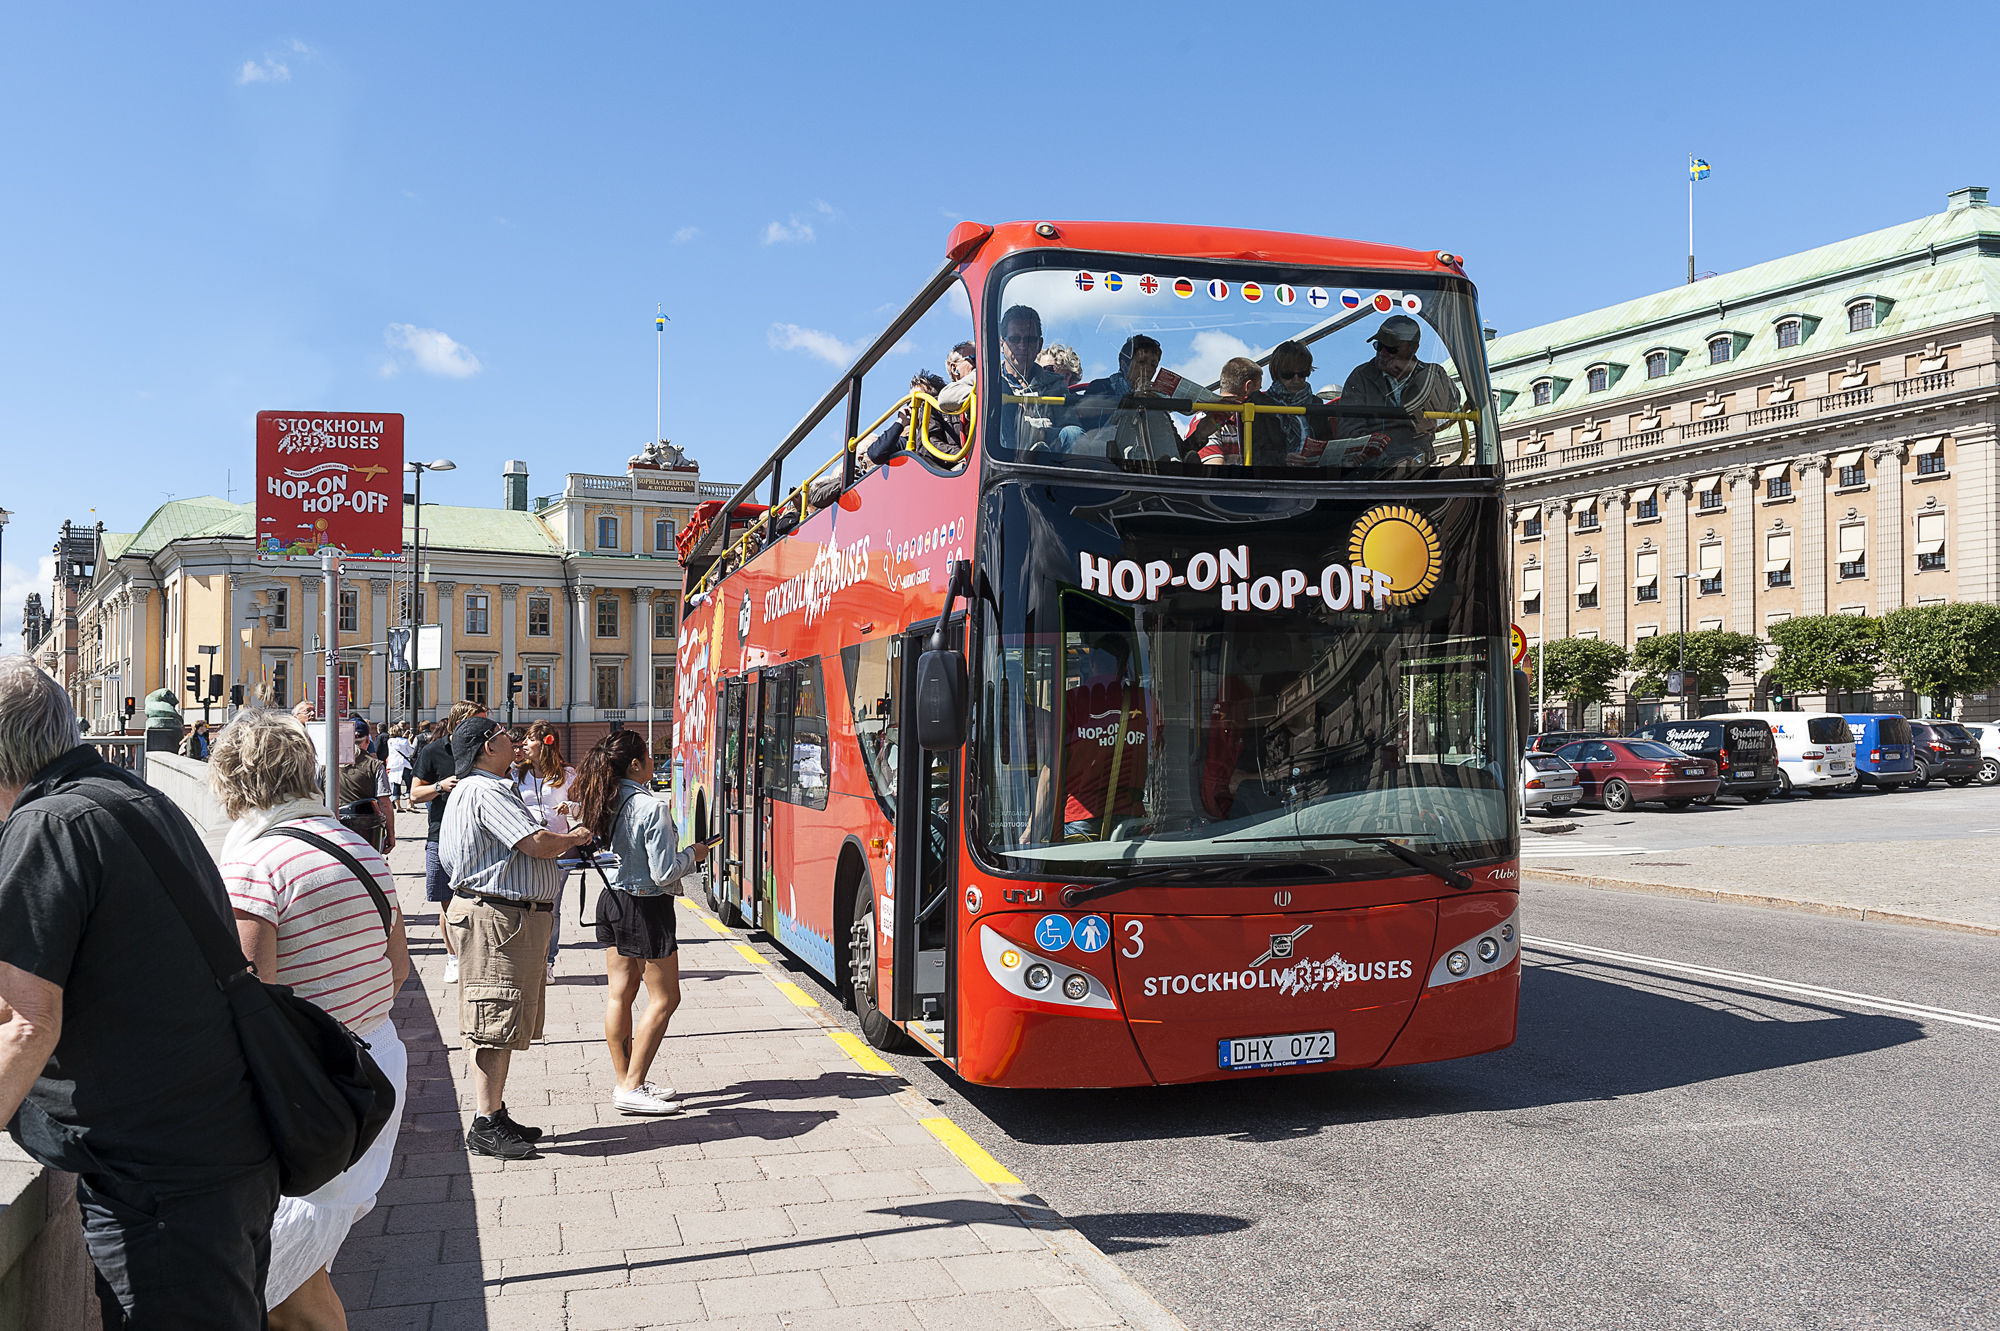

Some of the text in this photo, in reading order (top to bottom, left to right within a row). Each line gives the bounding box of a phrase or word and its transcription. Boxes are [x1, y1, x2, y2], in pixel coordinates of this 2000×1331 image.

[278, 418, 384, 434] STOCKHOLM
[326, 435, 380, 450] BUSES
[267, 474, 347, 500] HOP-ON
[303, 490, 389, 513] HOP-OFF
[764, 568, 814, 625] STOCKHOLM
[833, 534, 870, 594] BUSES
[1080, 545, 1250, 601] HOP-ON
[1221, 563, 1393, 612] HOP-OFF
[1666, 728, 1710, 742] Grödinge
[1730, 727, 1768, 740] Grödinge
[1121, 919, 1144, 959] 3
[1144, 967, 1291, 997] STOCKHOLM
[1344, 959, 1413, 982] BUSES
[1234, 1035, 1330, 1063] DHX 072
